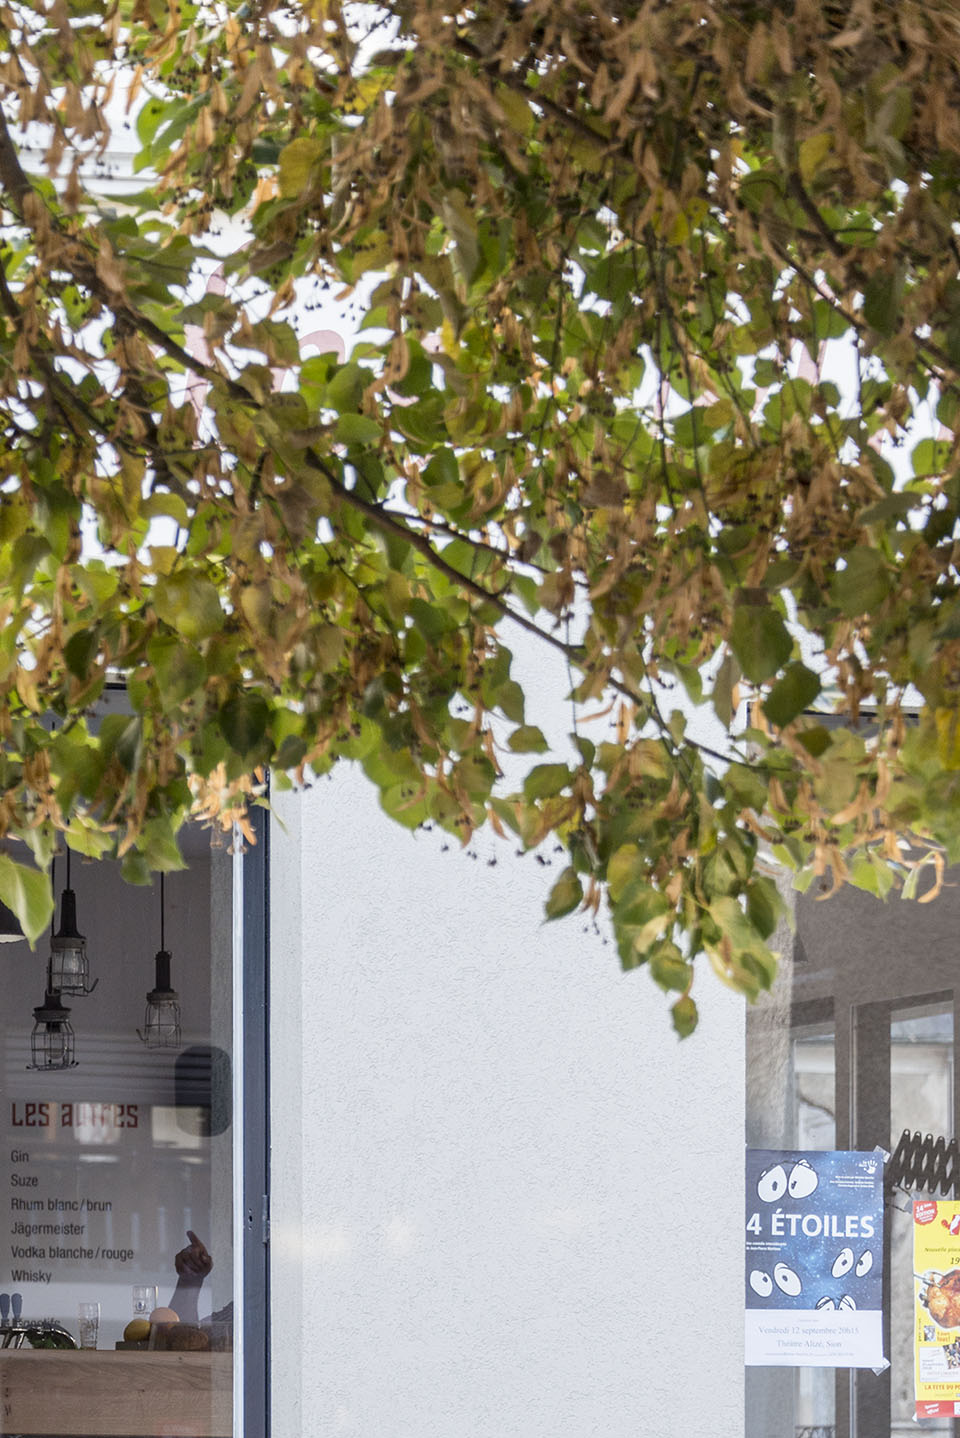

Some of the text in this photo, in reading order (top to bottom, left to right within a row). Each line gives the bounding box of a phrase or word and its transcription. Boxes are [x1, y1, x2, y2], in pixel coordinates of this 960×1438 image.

[11, 1150, 30, 1162] Gin
[11, 1174, 39, 1187] Suze
[11, 1198, 44, 1211] Rhum
[11, 1222, 85, 1237] Jägermeister
[746, 1208, 875, 1239] 4 ÉTOILES
[11, 1246, 45, 1259] Vodka
[11, 1270, 52, 1284] Whisky
